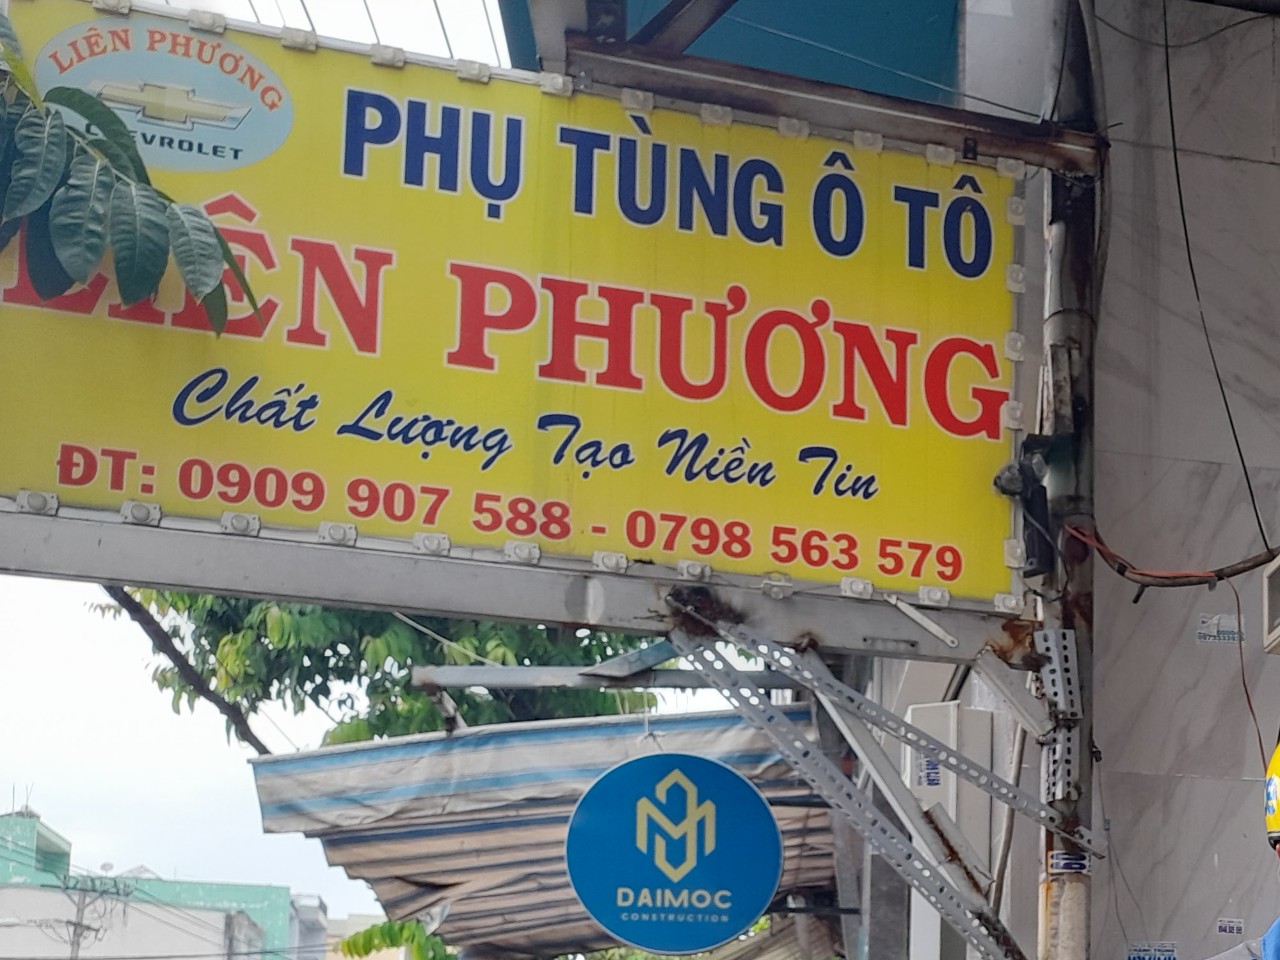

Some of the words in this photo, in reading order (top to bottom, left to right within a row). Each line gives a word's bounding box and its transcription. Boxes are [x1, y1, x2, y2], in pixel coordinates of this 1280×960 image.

[48, 27, 132, 75] LIÊN
[146, 28, 283, 114] PHƯƠNG
[85, 122, 244, 161] CVROLET
[343, 89, 523, 219] PHỤ
[559, 115, 785, 247] TÙNG
[812, 151, 865, 257] Ô
[893, 174, 993, 279] TÔ
[2, 193, 395, 356] LÊN
[445, 260, 1010, 440] PHƯƠNG
[171, 367, 320, 431] Chất
[337, 389, 513, 471] Lượng
[537, 413, 635, 479] Tạo
[657, 428, 777, 488] Niền
[798, 446, 880, 500] Tin
[57, 443, 157, 494] ĐT:
[178, 458, 326, 512] 0909
[346, 477, 452, 526] 907
[472, 493, 571, 541] 588
[625, 508, 753, 560] 0798
[770, 525, 860, 572] 563
[877, 540, 963, 582] 579
[616, 887, 733, 910] DAIMOC
[620, 912, 730, 923] CONSTRUCTION
